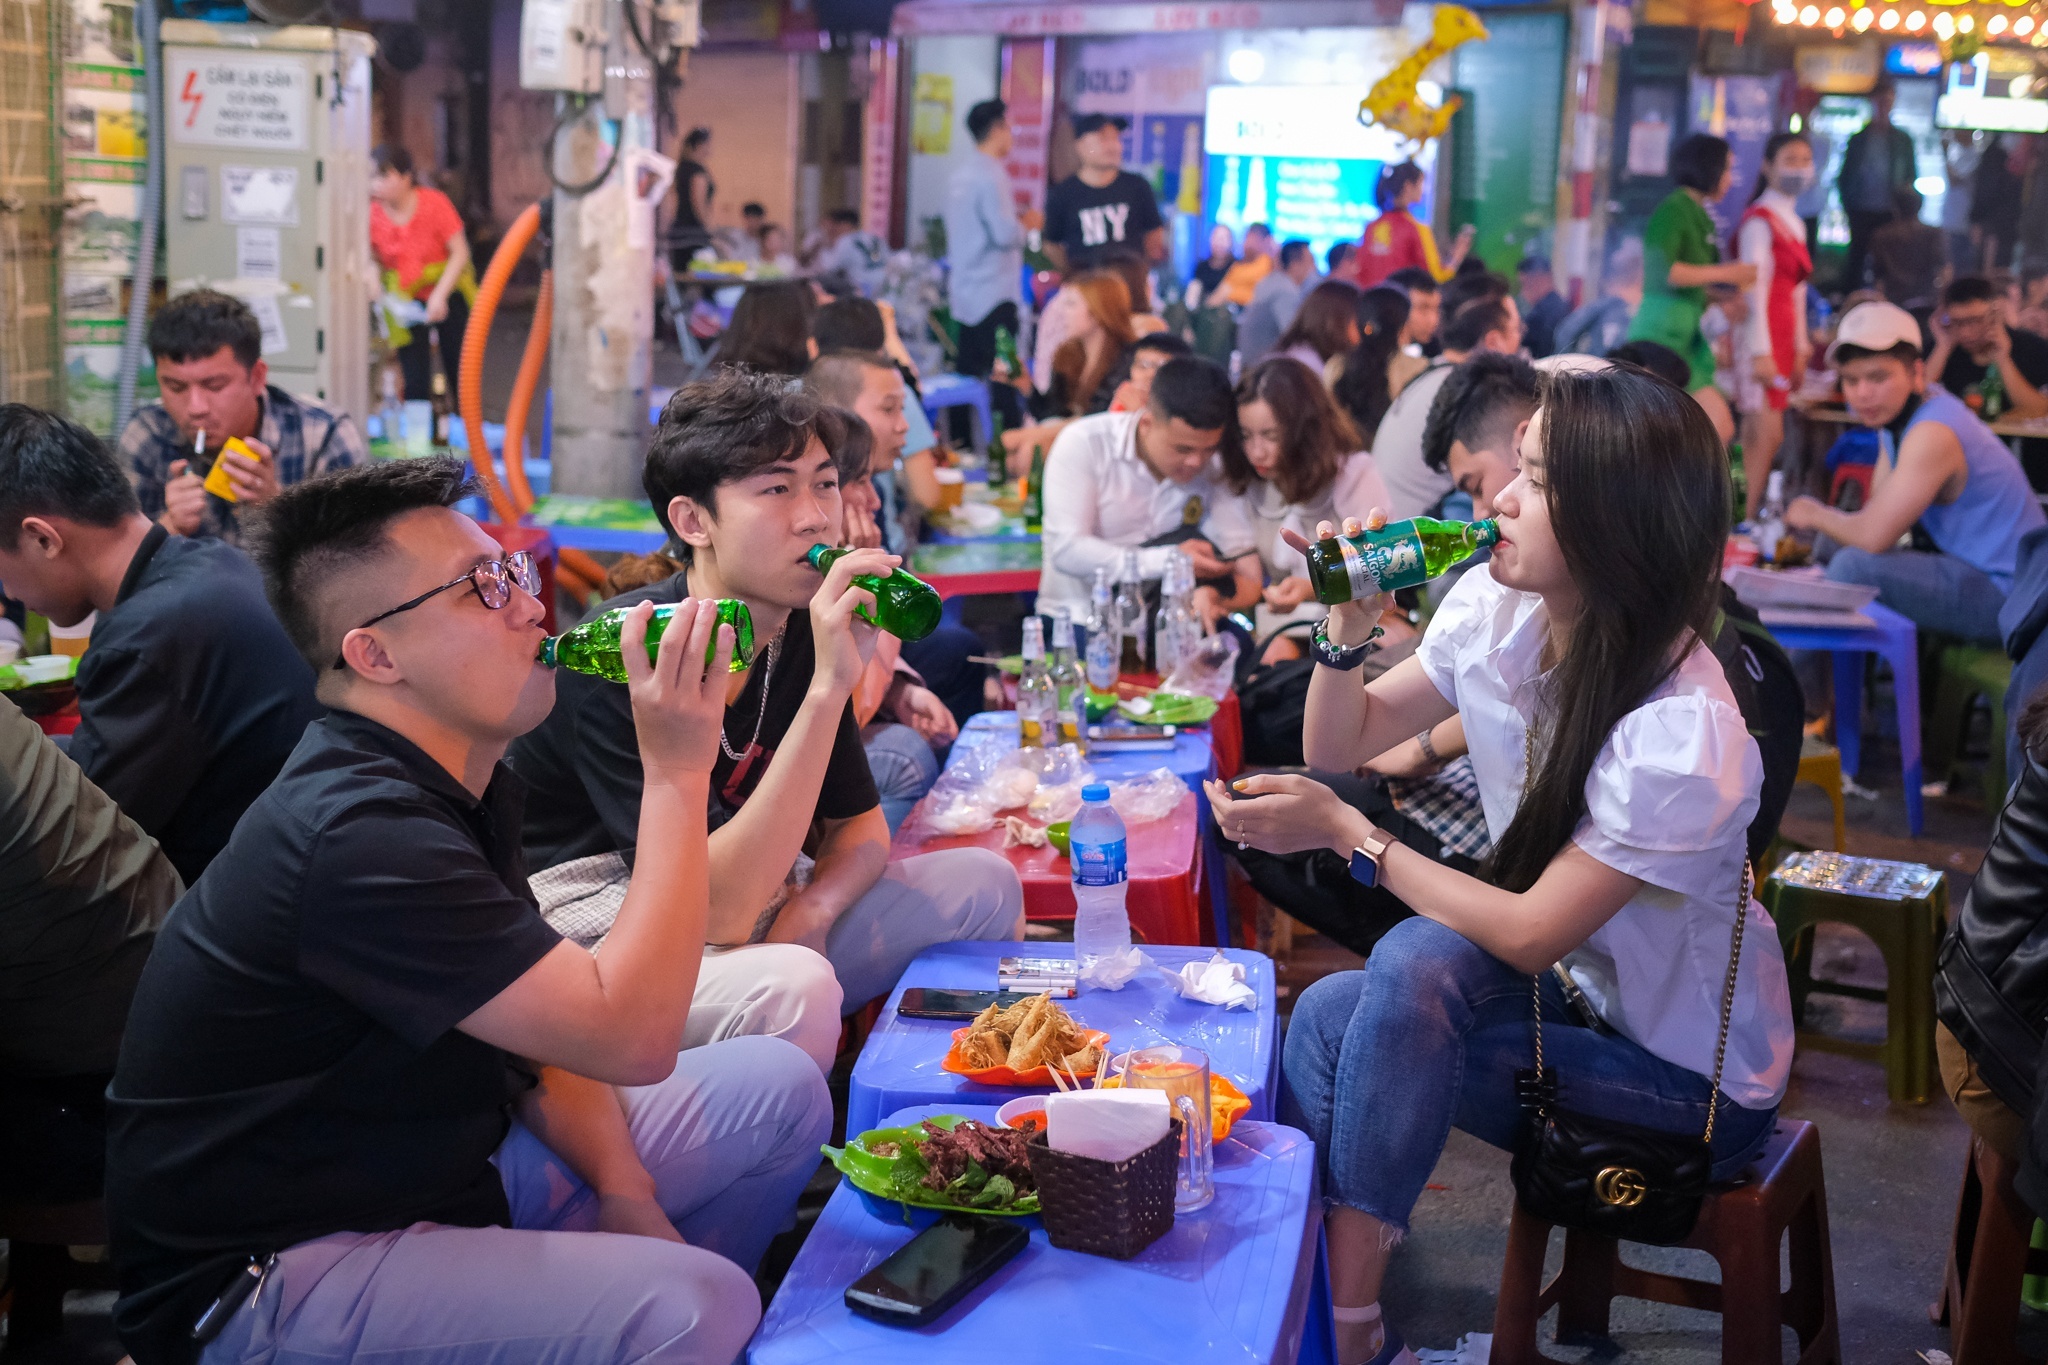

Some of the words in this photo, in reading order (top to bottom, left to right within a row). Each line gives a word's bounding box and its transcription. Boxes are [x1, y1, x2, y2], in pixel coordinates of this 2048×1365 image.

[1078, 202, 1130, 246] NY
[1363, 542, 1382, 585] SAIGON
[1377, 555, 1387, 570] BIA
